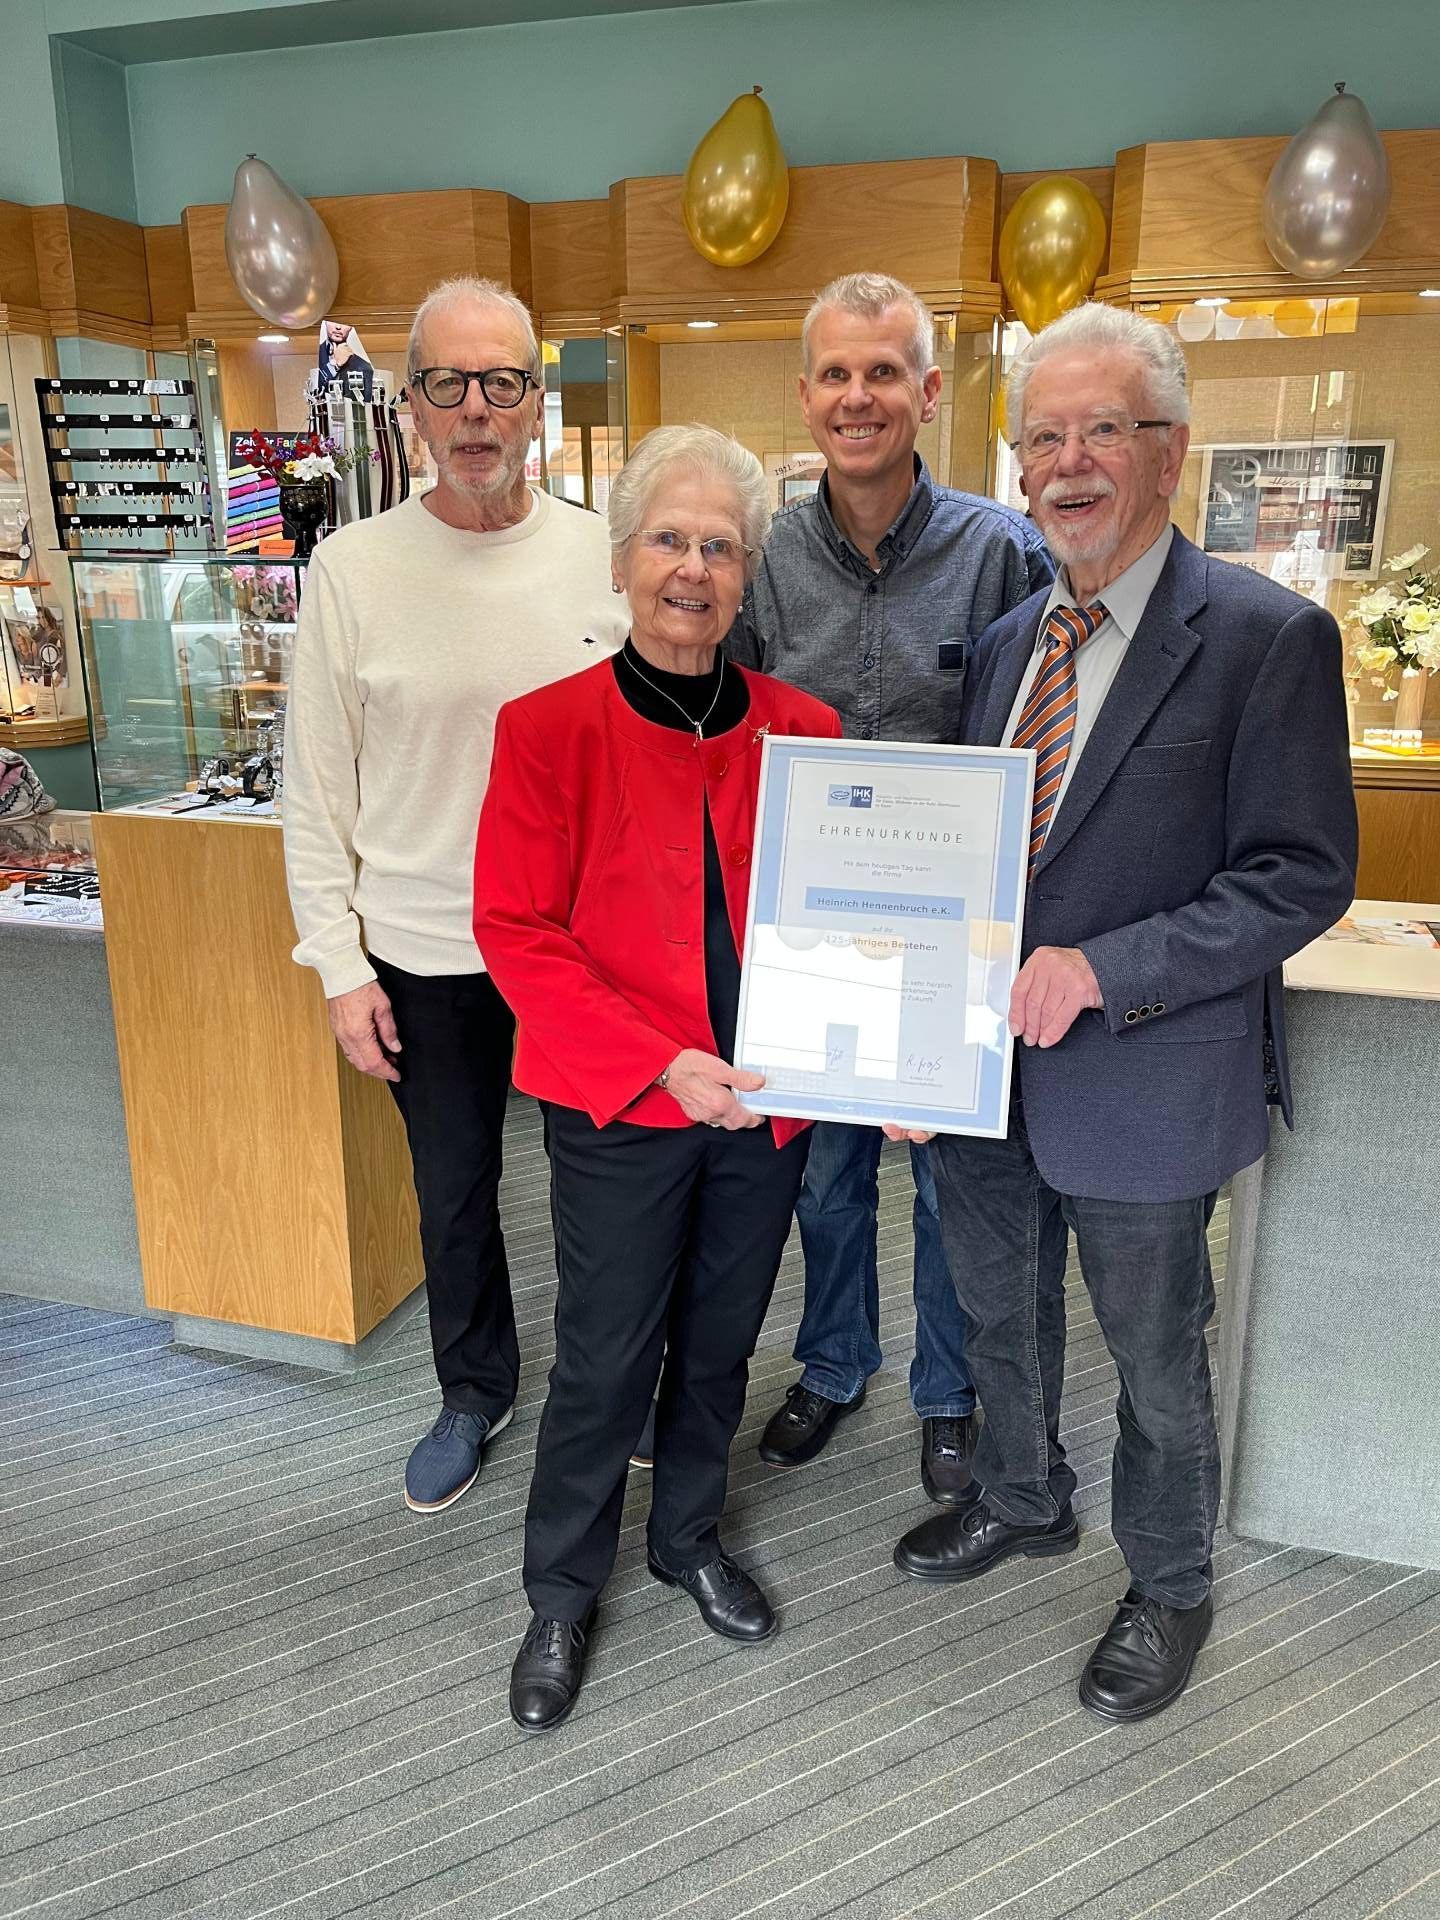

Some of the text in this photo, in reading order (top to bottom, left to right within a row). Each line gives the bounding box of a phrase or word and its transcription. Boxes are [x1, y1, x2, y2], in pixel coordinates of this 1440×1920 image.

[853, 788, 871, 799] IHK
[819, 824, 963, 844] EHRENURKUNDE
[871, 862, 900, 872] heutigen
[901, 864, 914, 873] Tag
[915, 865, 932, 873] kann
[883, 870, 902, 879] Firma
[817, 897, 951, 915] Heinrich Hennenbruch e.K.
[825, 935, 938, 951] 125-jähriges Bestehen
